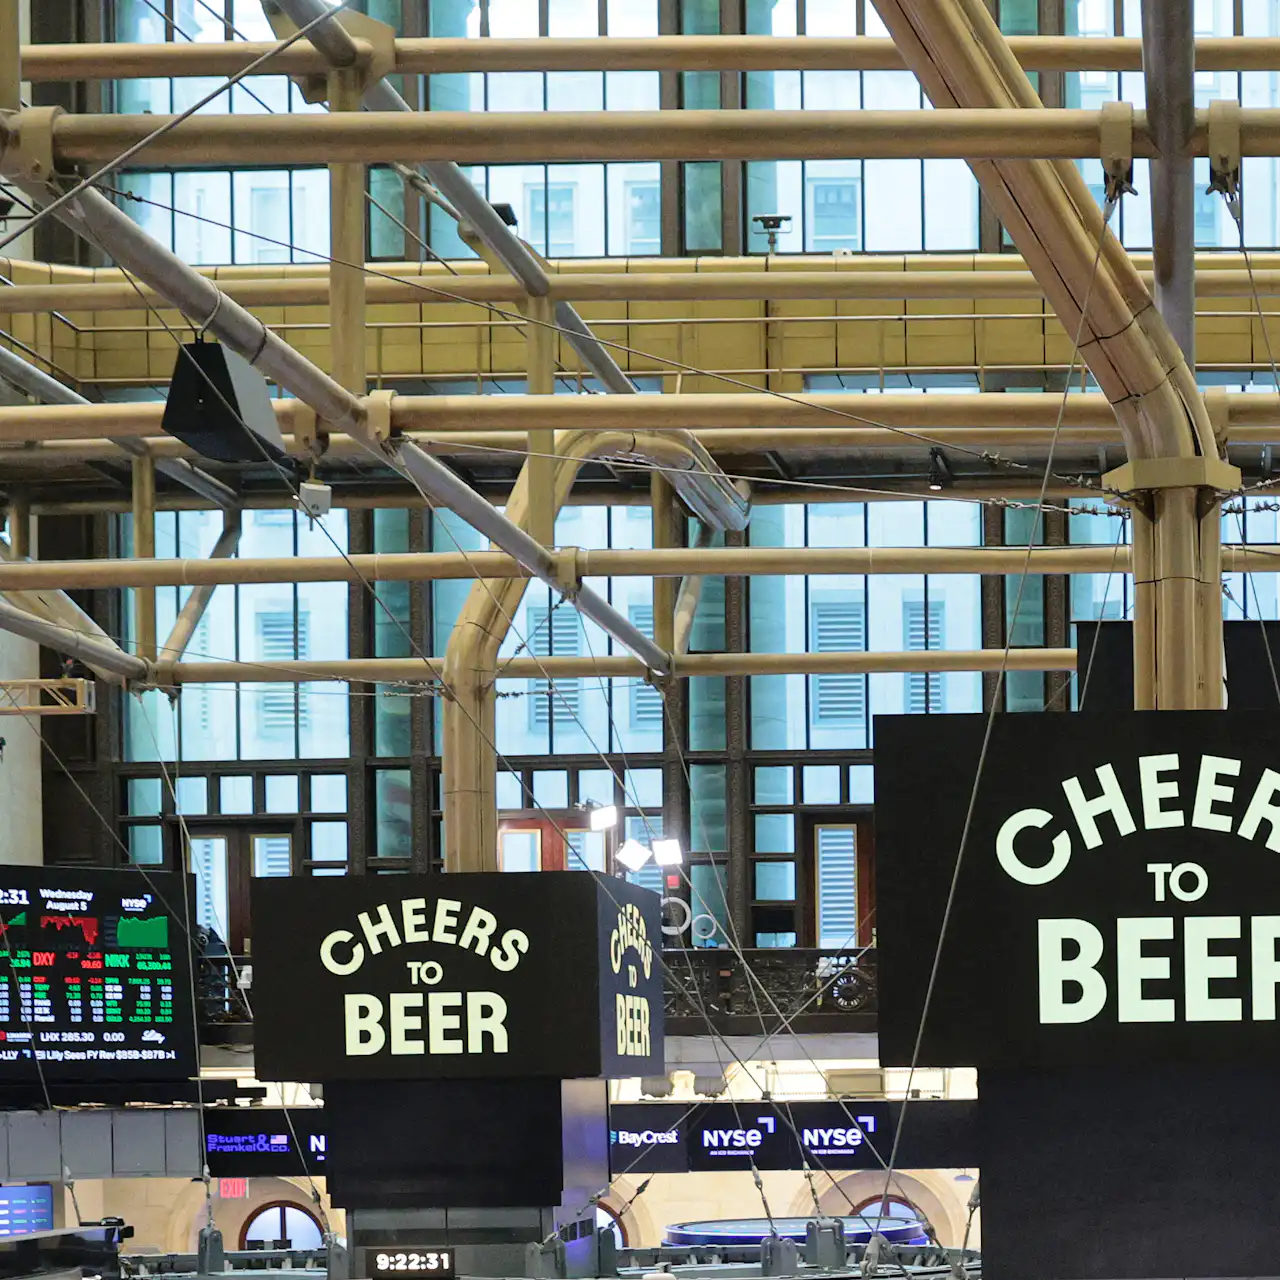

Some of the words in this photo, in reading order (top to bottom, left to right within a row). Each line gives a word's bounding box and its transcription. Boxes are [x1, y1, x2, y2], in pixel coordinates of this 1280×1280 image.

[1147, 862, 1208, 902] TO
[320, 898, 530, 975] CHEERS
[611, 903, 652, 979] CHEERS
[33, 952, 55, 967] DXY
[407, 961, 443, 985] TO
[629, 965, 637, 988] TO
[345, 991, 508, 1056] BEER
[616, 993, 650, 1057] BEER
[618, 1131, 678, 1147] BayCrest
[376, 1253, 450, 1271] 9:22:31
